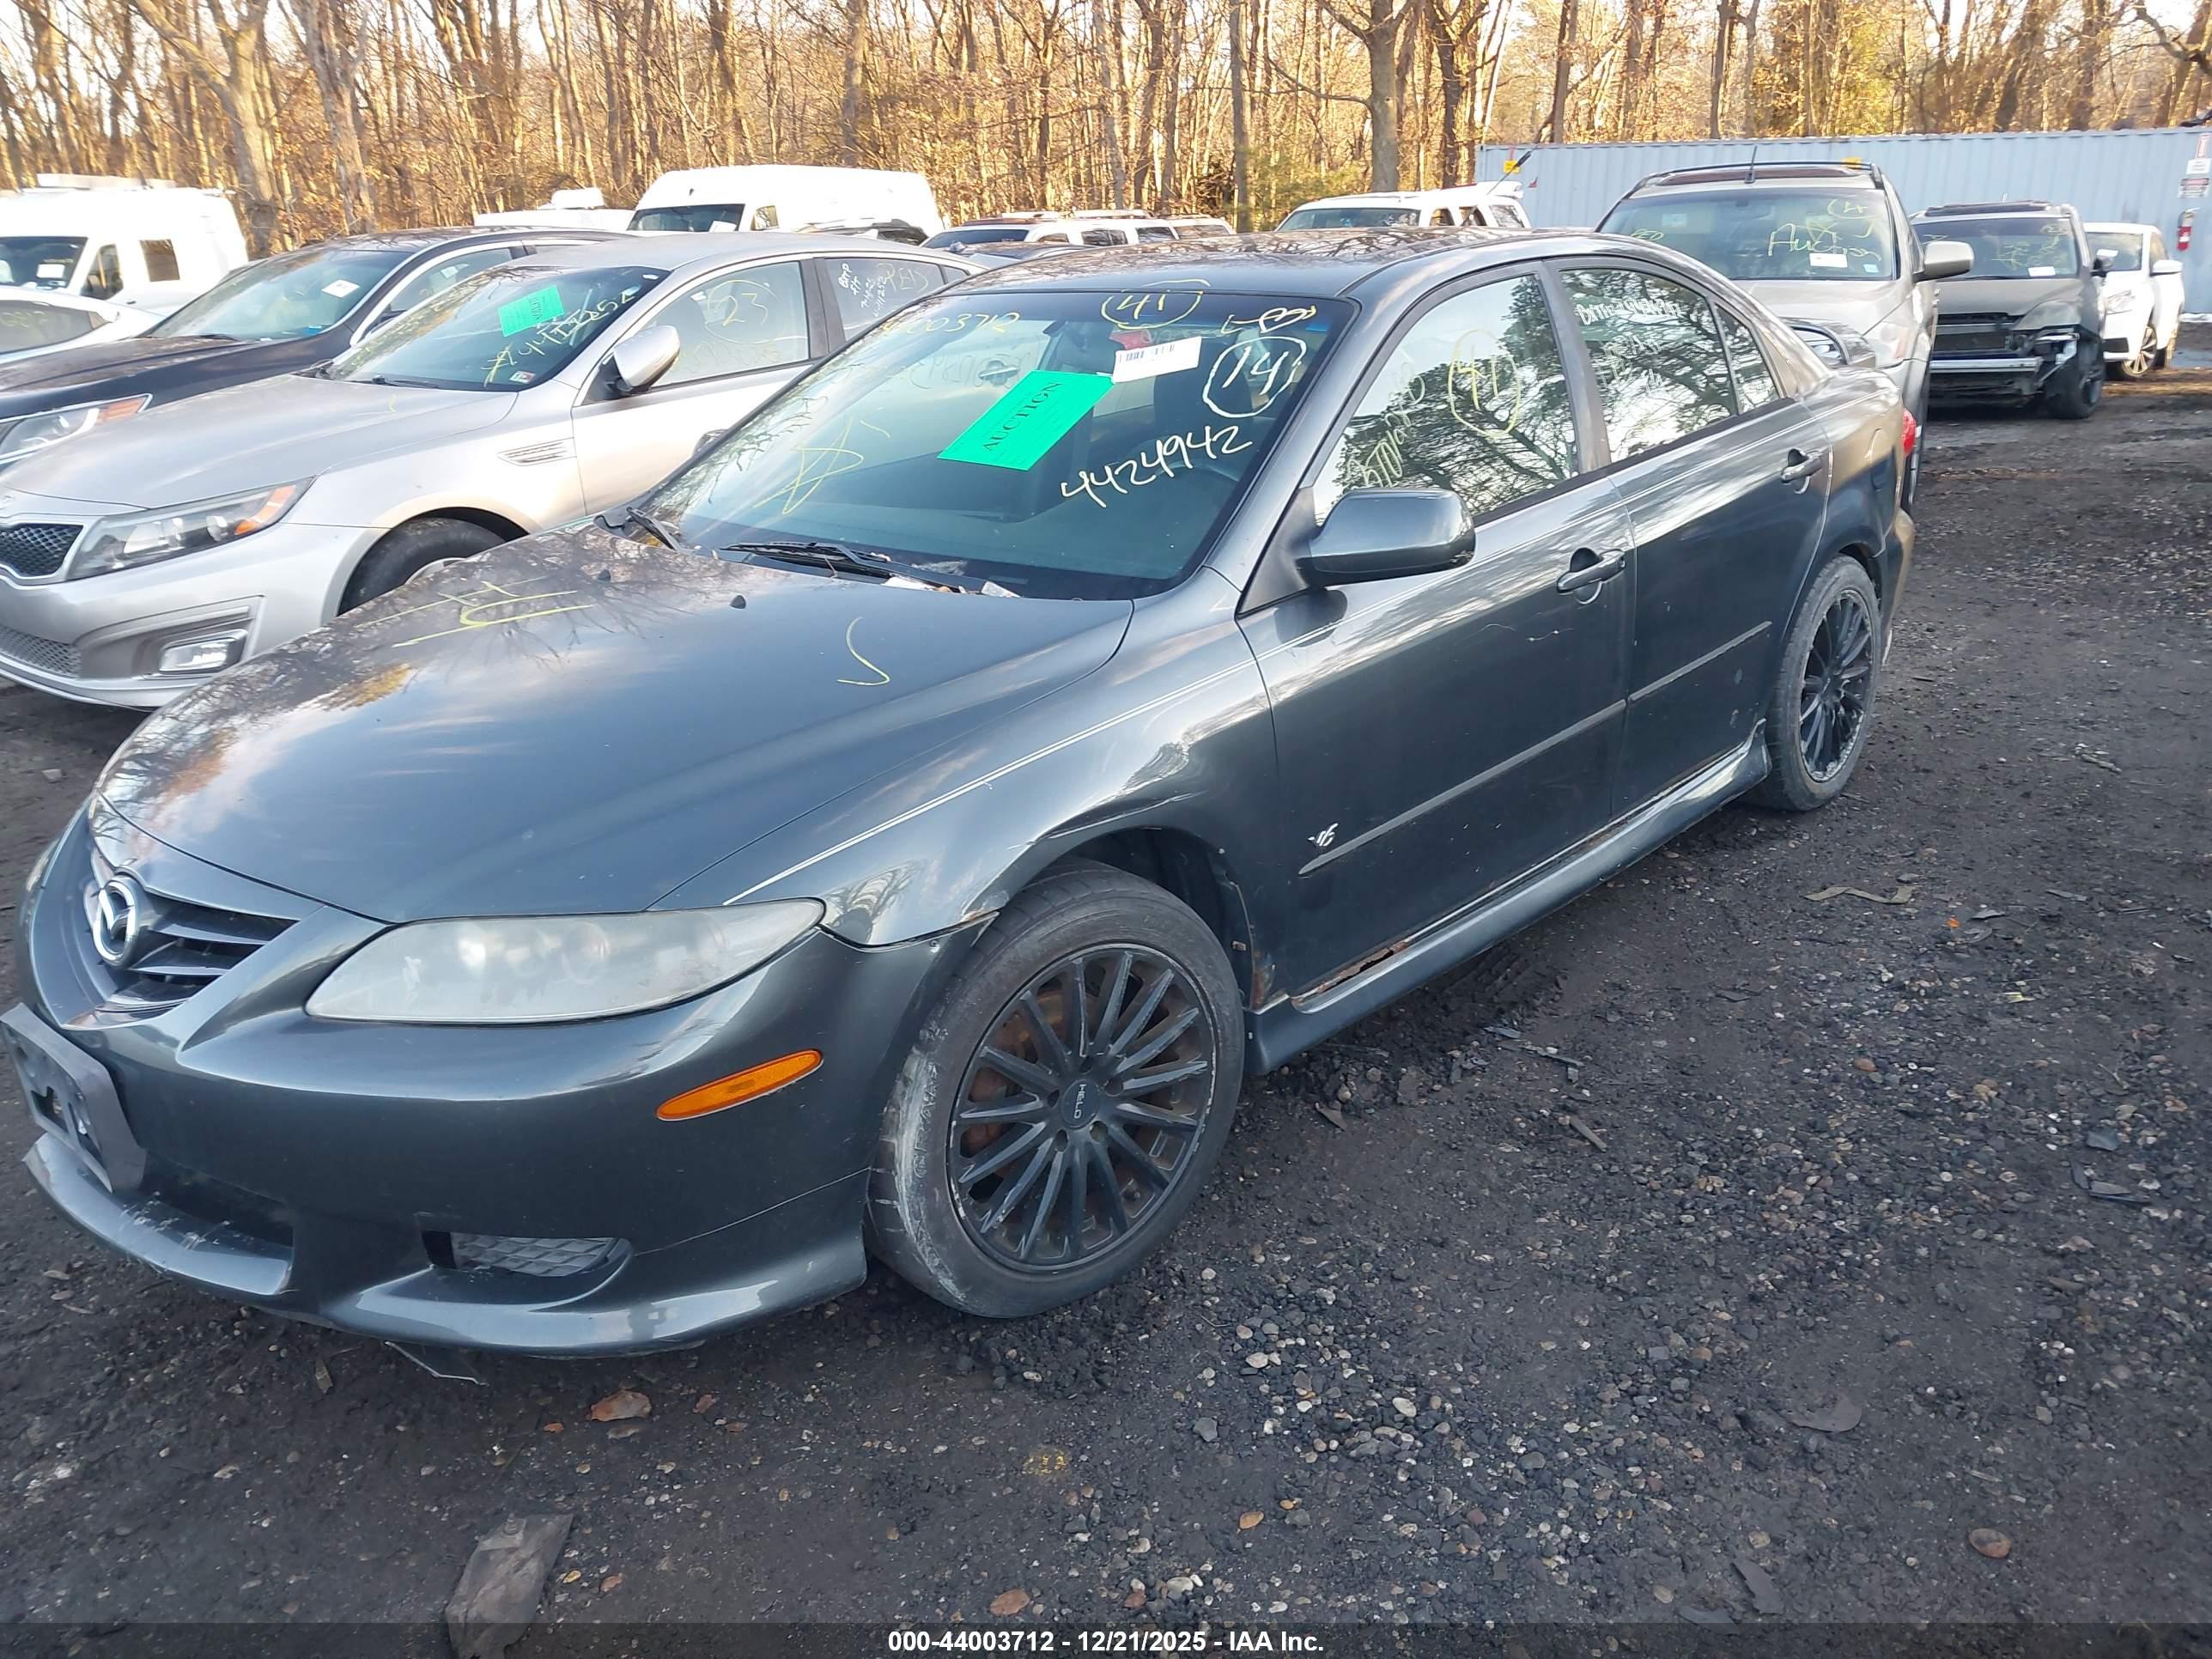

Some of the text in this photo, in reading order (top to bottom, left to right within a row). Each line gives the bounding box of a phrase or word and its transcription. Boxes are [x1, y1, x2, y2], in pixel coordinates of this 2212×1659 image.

[715, 292, 769, 327] 23
[1116, 294, 1166, 319] 41
[1222, 345, 1290, 395] 14
[1060, 425, 1254, 508] 4424942
[1073, 1083, 1087, 1120] HELO
